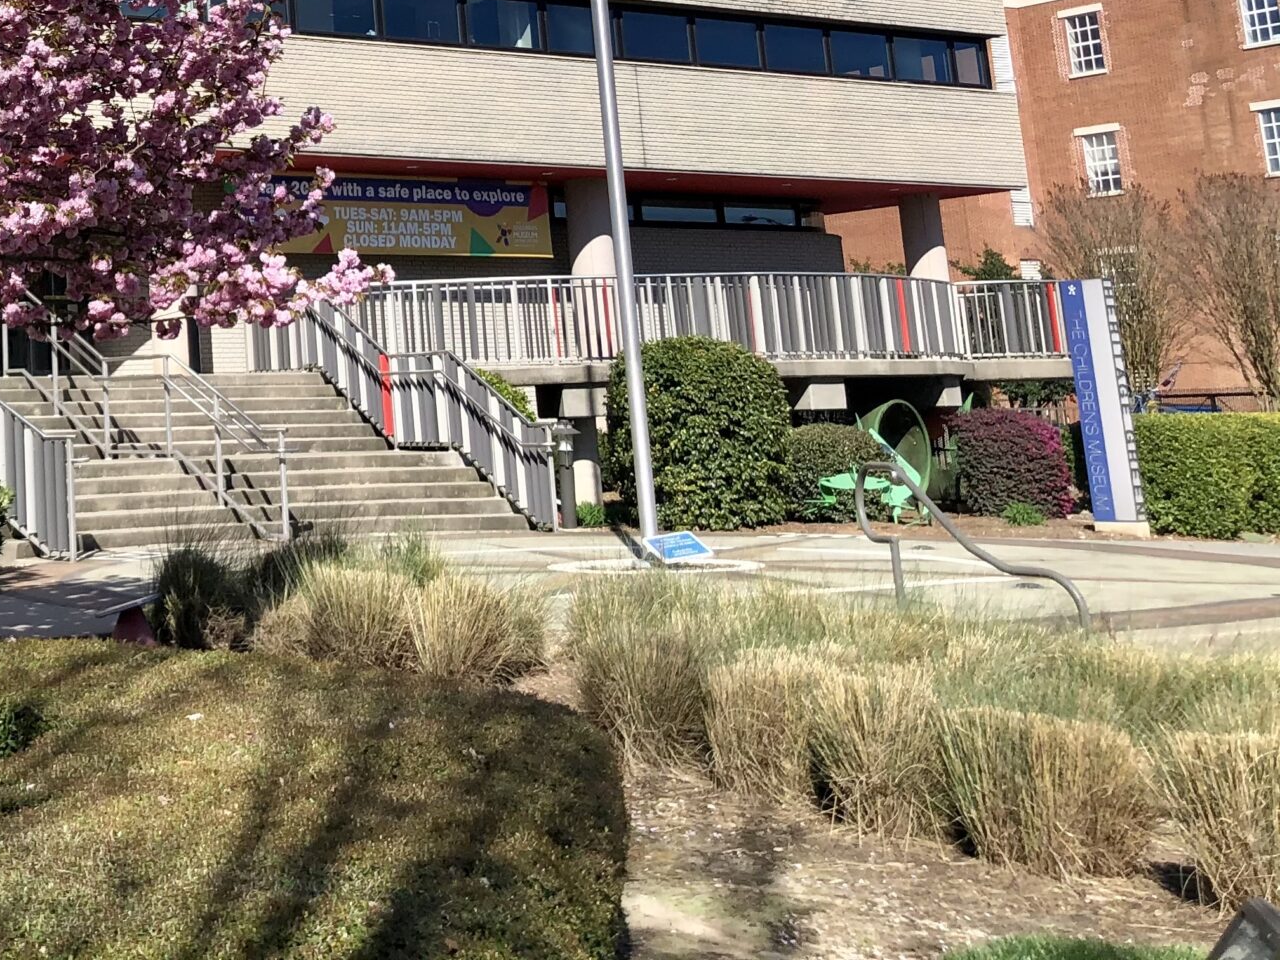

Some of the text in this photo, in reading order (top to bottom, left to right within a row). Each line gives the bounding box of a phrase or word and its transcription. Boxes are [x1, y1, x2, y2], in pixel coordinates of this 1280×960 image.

[331, 182, 362, 197] with
[366, 186, 375, 197] a
[378, 184, 409, 198] safe
[413, 185, 452, 201] place
[454, 187, 470, 200] to
[473, 189, 525, 204] explore
[333, 206, 463, 223] TUES-SAT: 9AM-5PM
[346, 221, 452, 236] SUN: 11AM-5PM
[343, 234, 457, 249] CLOSED MONDAY
[1071, 308, 1086, 340] THE
[1087, 440, 1111, 511] MUSEUM
